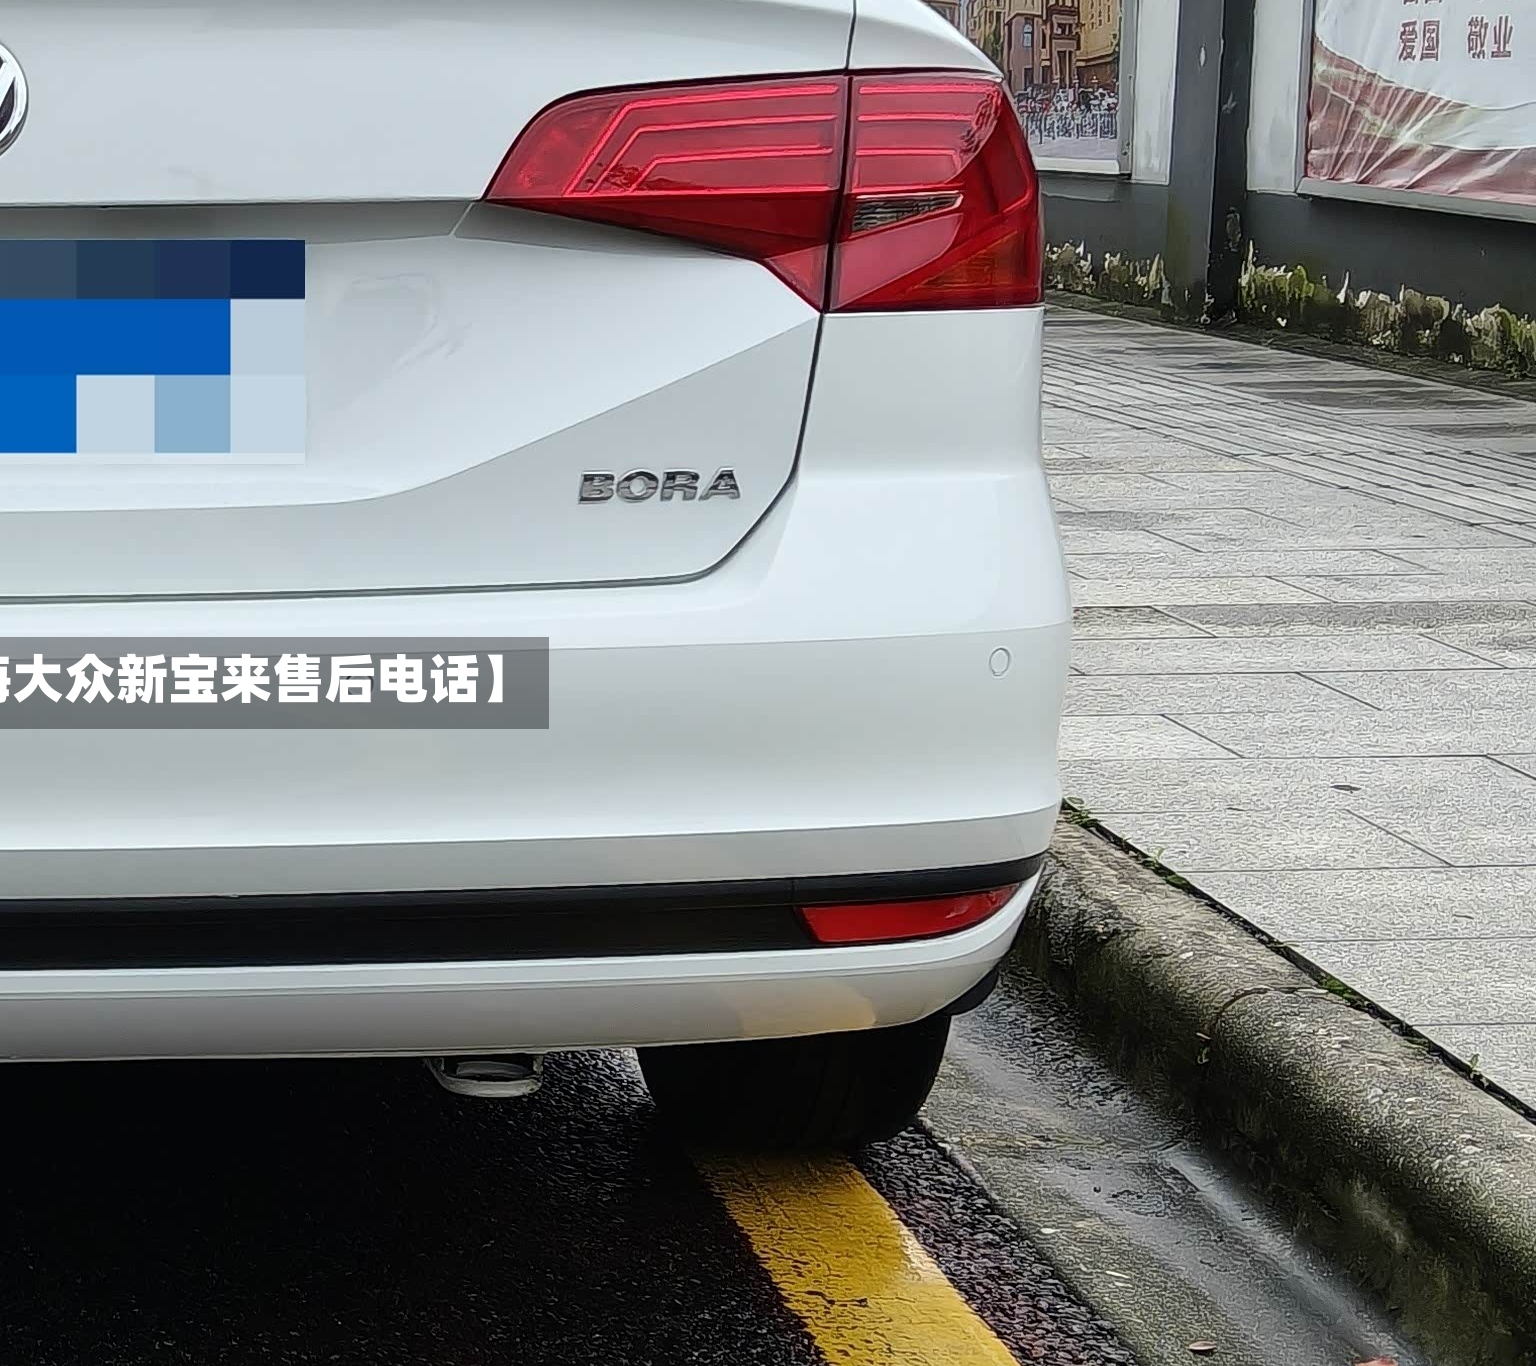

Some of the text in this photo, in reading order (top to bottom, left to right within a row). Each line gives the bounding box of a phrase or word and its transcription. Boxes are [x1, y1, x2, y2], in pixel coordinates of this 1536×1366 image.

[1398, 15, 1514, 61] 爱国 敬业
[578, 467, 740, 503] BORA
